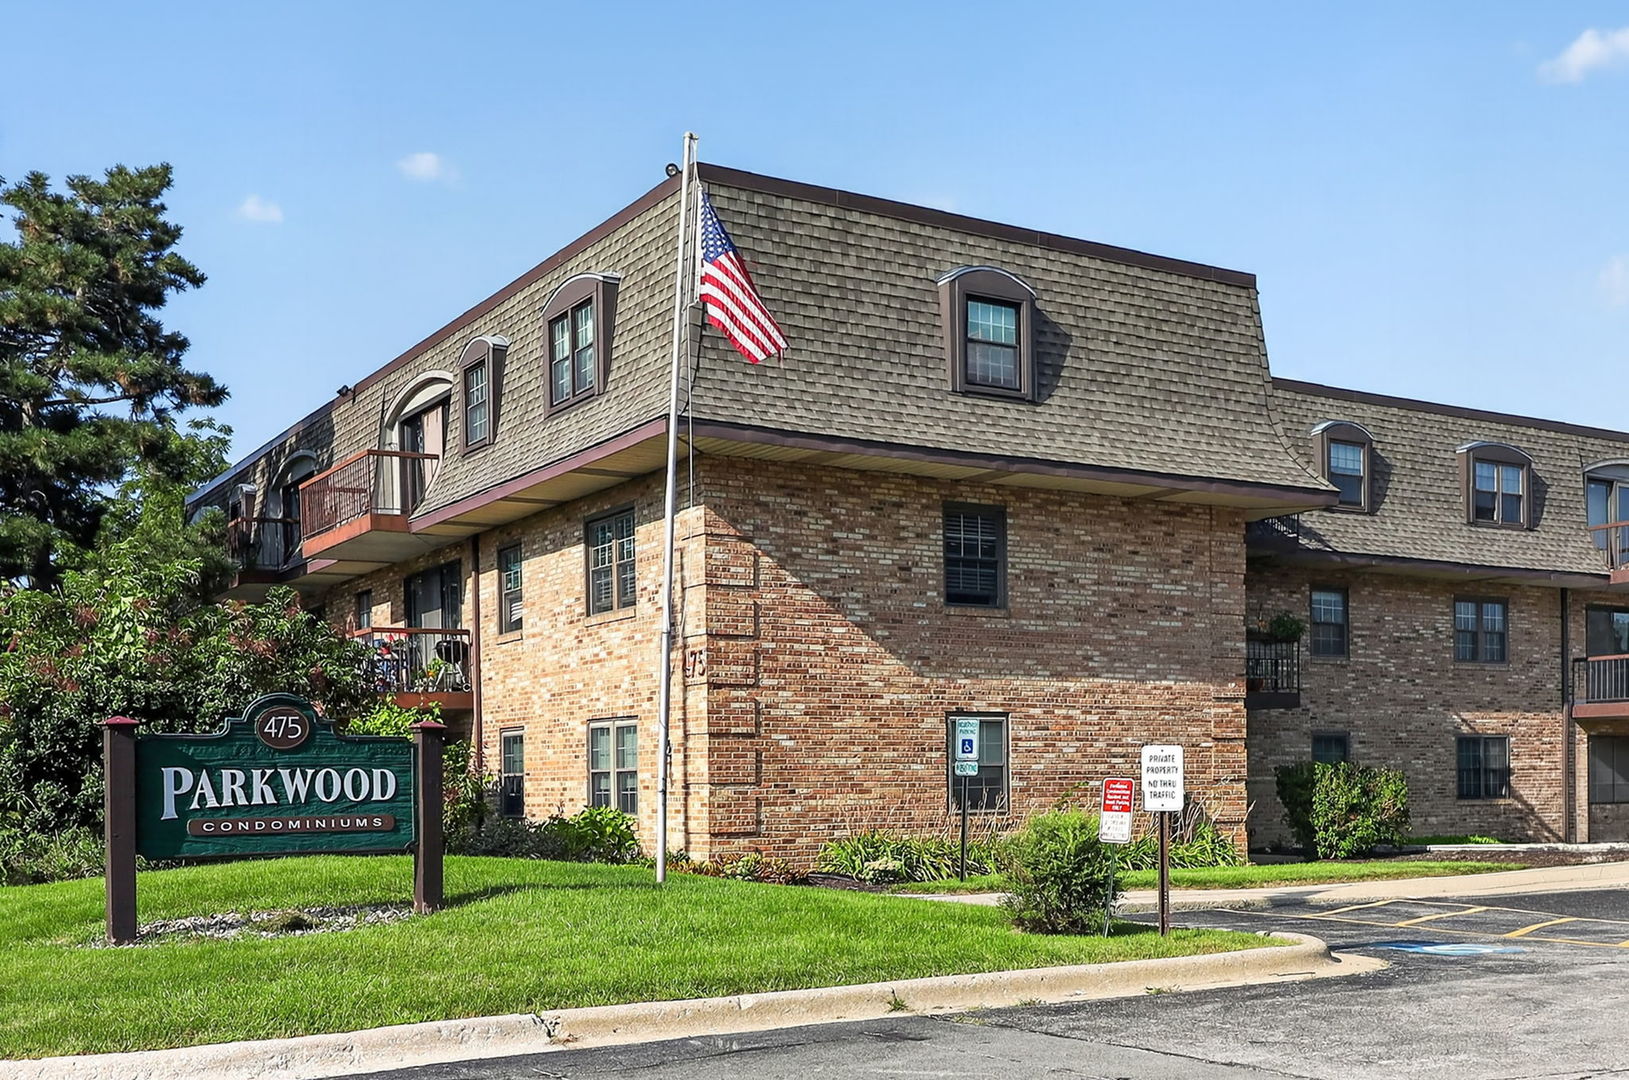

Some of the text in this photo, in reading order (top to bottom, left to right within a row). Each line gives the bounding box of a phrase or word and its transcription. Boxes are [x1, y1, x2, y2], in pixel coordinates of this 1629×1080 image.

[263, 716, 302, 739] 475
[1146, 766, 1178, 774] PROPERTY
[1148, 780, 1177, 788] NO THRU
[1149, 791, 1176, 799] TRAFFIC
[202, 817, 383, 832] CONDOMINIUMS
